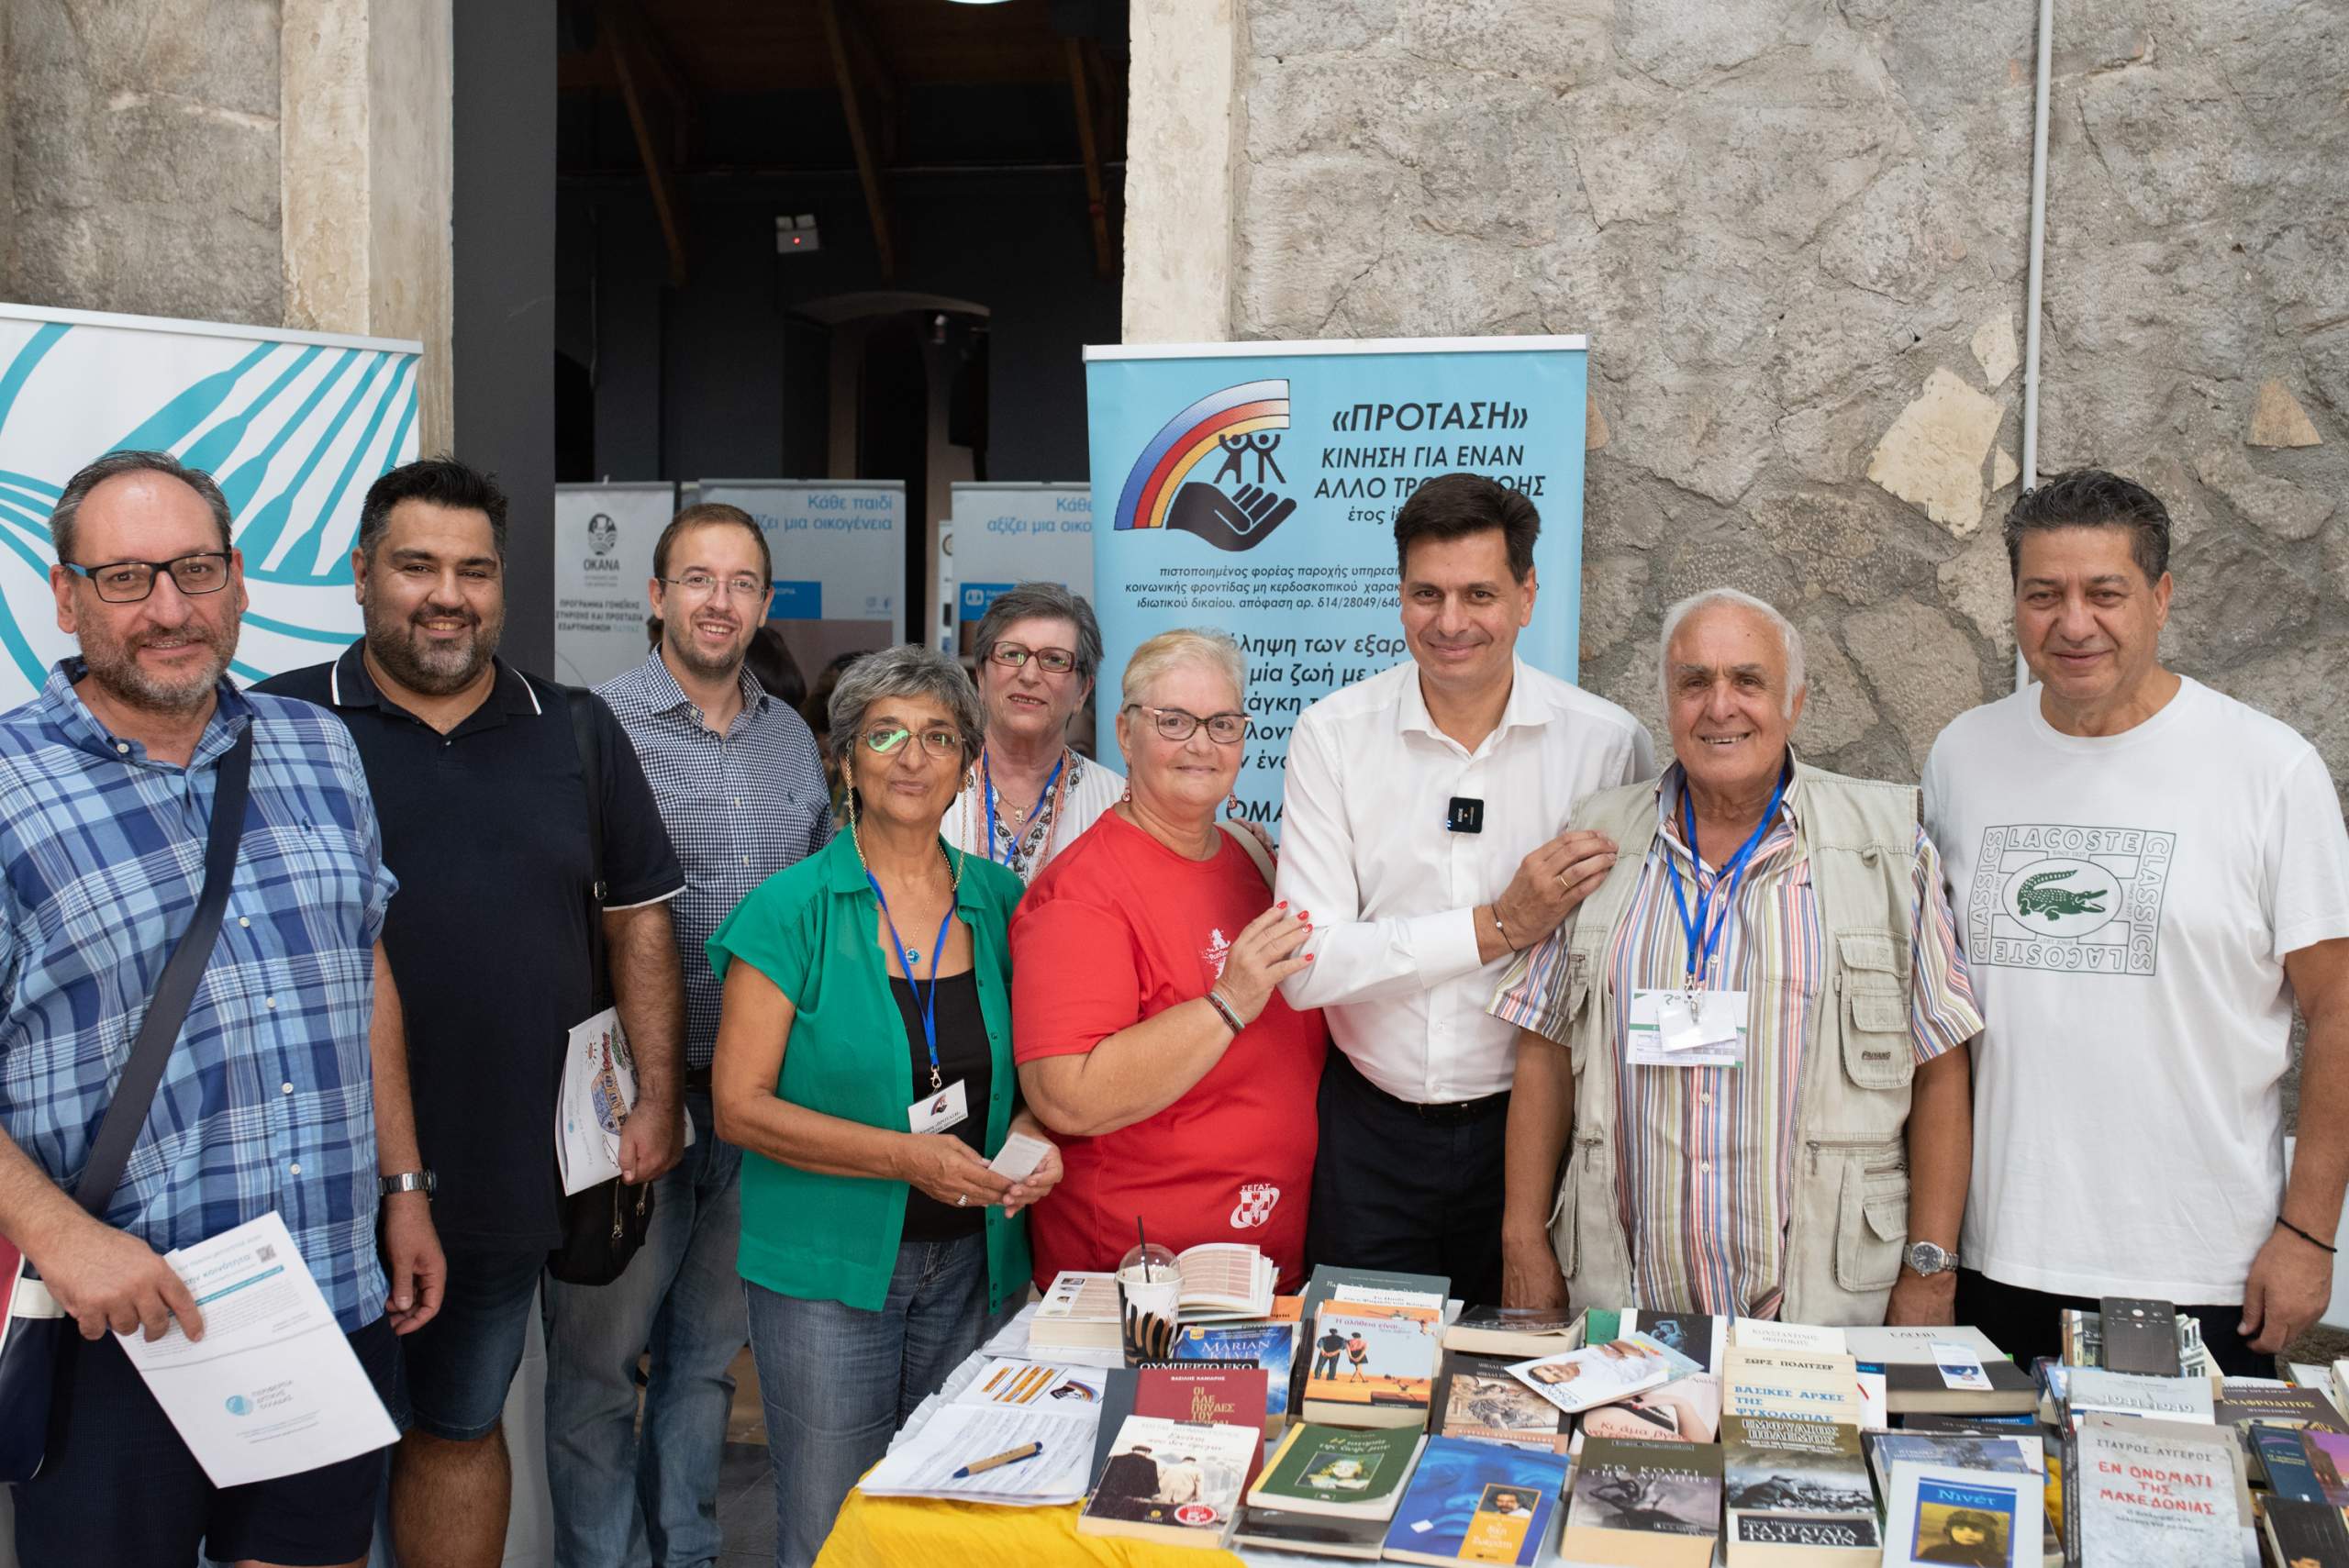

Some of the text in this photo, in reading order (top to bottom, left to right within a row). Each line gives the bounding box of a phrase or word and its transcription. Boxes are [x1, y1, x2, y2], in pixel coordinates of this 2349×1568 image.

[1332, 401, 1528, 431] «ΠΡΟΤΑΣΗ»
[1321, 445, 1524, 468] ΚΙΝΗΣΗ ΓΙΑ ΕΝΑΝ
[1314, 477, 1386, 498] ΑΛΛΟ
[1486, 475, 1546, 496] ΩΗΣ
[807, 495, 893, 510] Κάθε παιδί
[785, 516, 807, 532] μια
[814, 515, 893, 533] οικογένεια
[986, 517, 1028, 535] αξίζει
[1032, 520, 1056, 534] μια
[1348, 506, 1386, 525] έτος
[1160, 564, 1400, 579] πιστοποιημένος φορέας παροχής υπηρεσι
[1125, 581, 1400, 595] κοινωνικής φροντίδας μη κερδοσκοπικού χαρακ
[1137, 596, 1188, 608] ιδιωτικού
[1191, 596, 1235, 608] δικαίου.
[1239, 597, 1293, 610] απόφαση
[1297, 599, 1314, 610] αρ.
[1231, 633, 1406, 657] ληψη των εξαρ
[1249, 662, 1283, 686] μία
[1290, 662, 1334, 686] ζωή
[1244, 691, 1301, 715] άγκη
[2009, 828, 2140, 853] LACOSTE
[1971, 829, 2003, 960] CLASSICS
[2131, 837, 2170, 971] CLASSICS
[1995, 941, 2122, 970] LACOSTE
[1202, 1340, 1271, 1353] MARIAN
[1193, 1386, 1205, 1396] ΟΙ
[1734, 1386, 1845, 1402] ΒΑΣΙΚΕΣ ΑΡΧΕΣ
[1735, 1396, 1763, 1406] ΤΗΣ
[1735, 1407, 1834, 1423] ΨΥΧΟΛΟΓΙΑΣ
[2098, 1439, 2212, 1462] ΣΤΑΥΡΟΣ ΛΥΓΕΡΟΣ
[2099, 1461, 2213, 1489] ΕΝ ΟΝΟΜΑΤΙ
[2139, 1482, 2173, 1496] ΤΗΣ
[2099, 1488, 2216, 1516] ΜΑΚΕΔΟΝΙΑΣ
